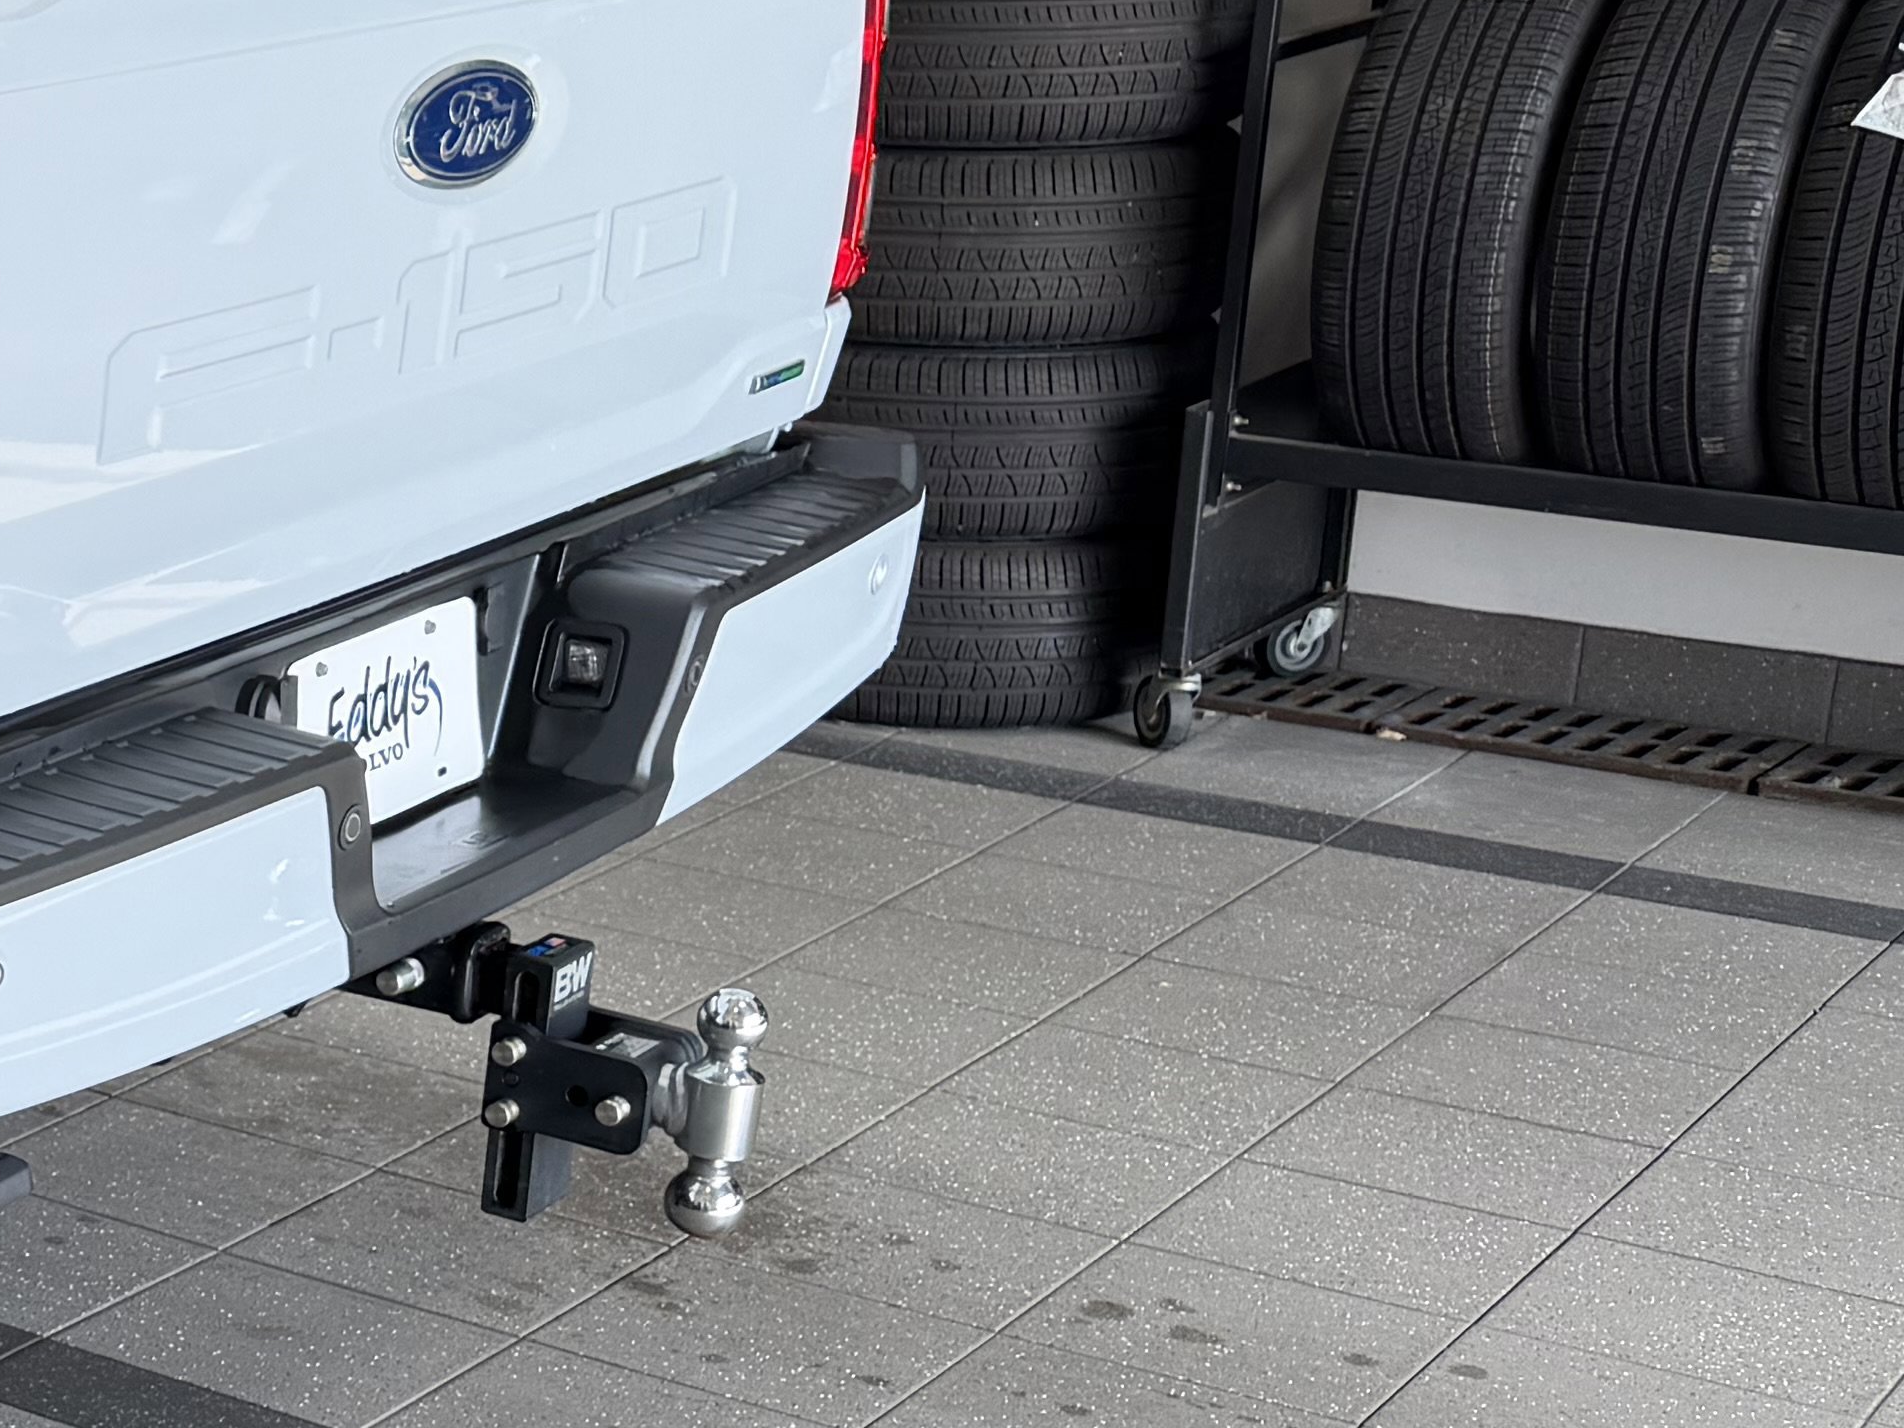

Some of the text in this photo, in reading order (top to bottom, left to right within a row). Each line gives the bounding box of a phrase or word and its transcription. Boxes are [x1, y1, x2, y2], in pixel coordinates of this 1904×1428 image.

[439, 89, 517, 164] Ford
[97, 176, 738, 466] F-150
[327, 655, 431, 749] Eddy's
[368, 741, 405, 771] LVO
